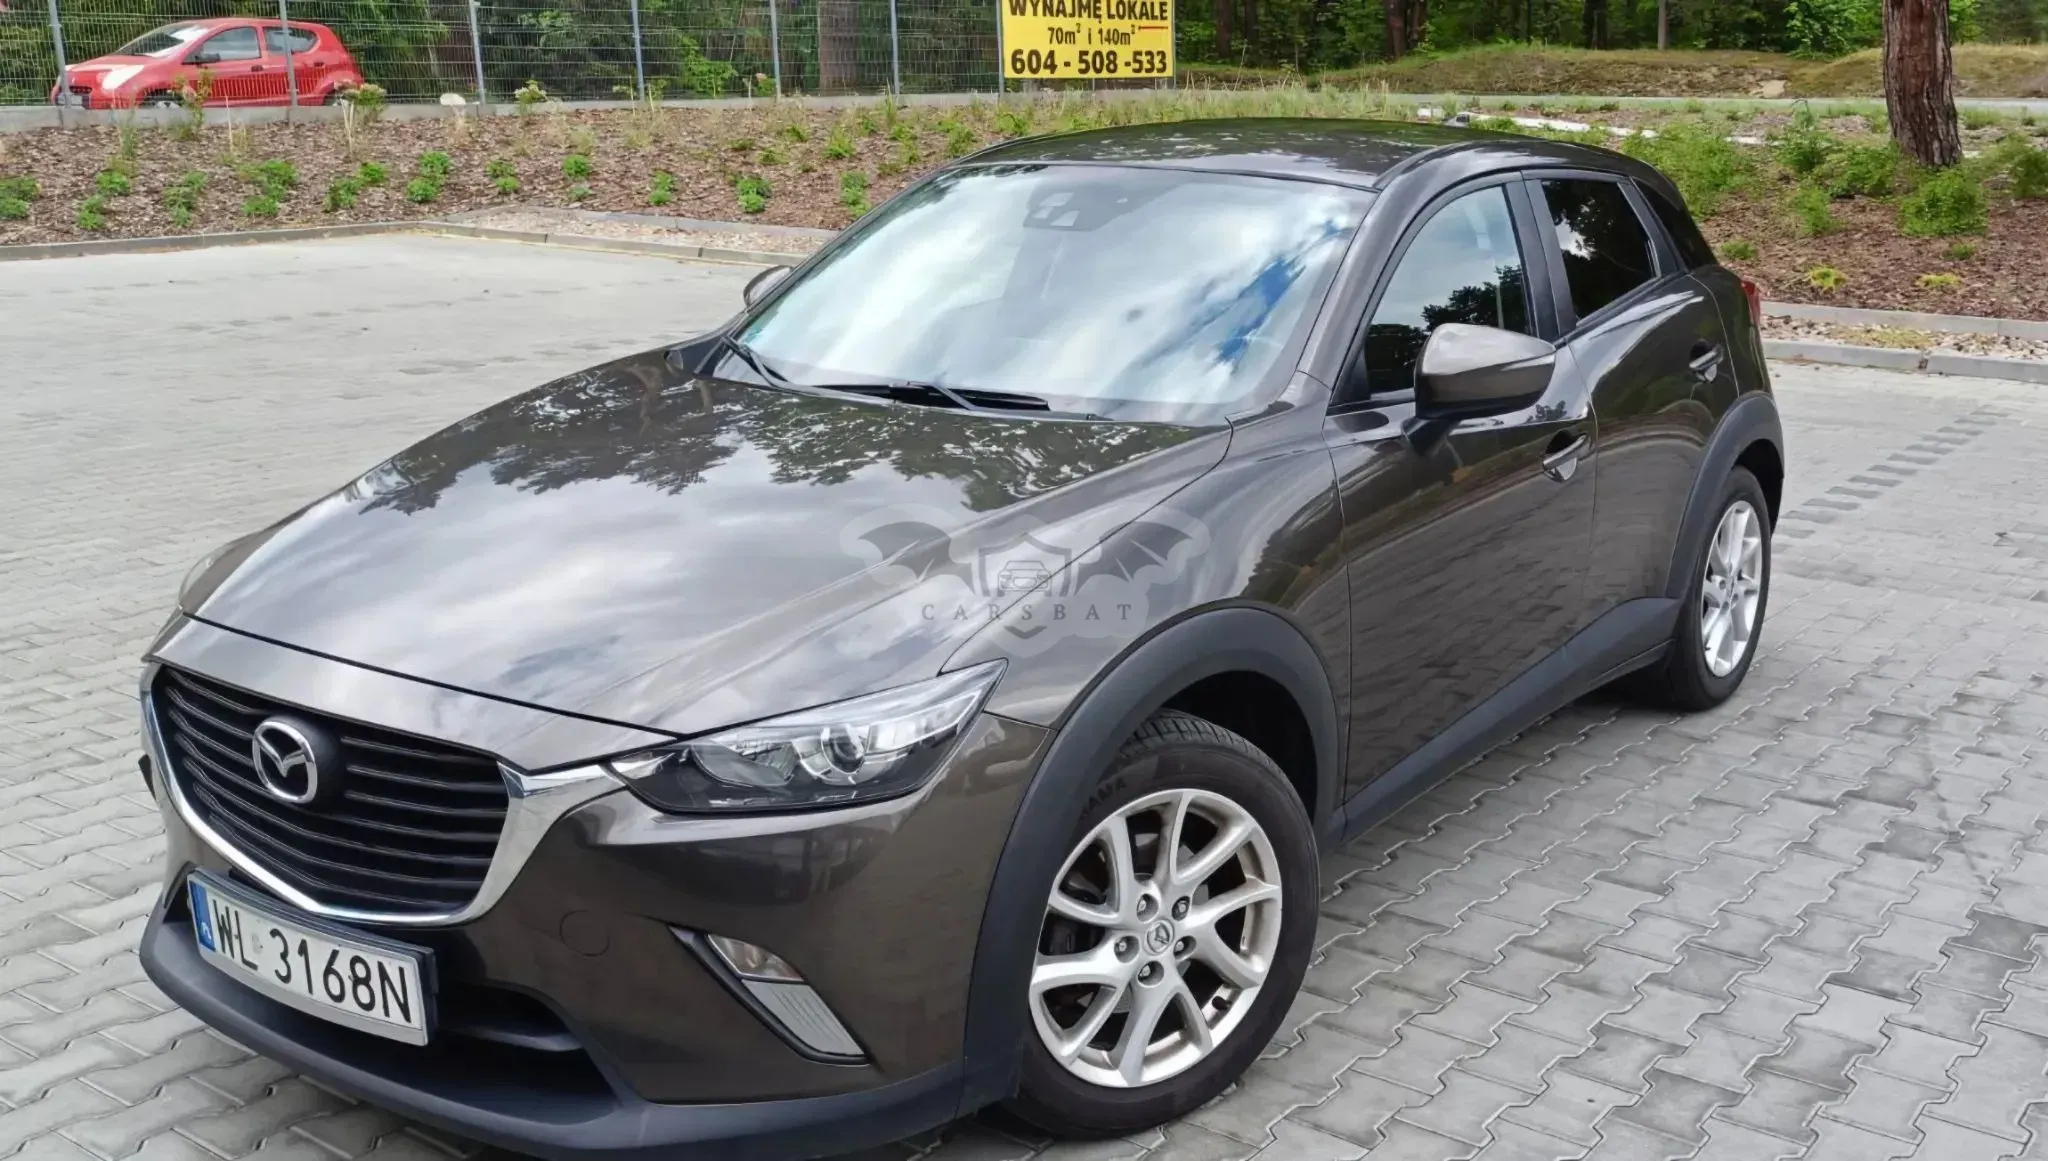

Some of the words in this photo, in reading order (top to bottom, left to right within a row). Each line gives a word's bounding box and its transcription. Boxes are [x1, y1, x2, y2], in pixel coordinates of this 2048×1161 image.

[1009, 0, 1102, 23] WYNAJMĘ
[1107, 0, 1168, 20] LOKALE
[1087, 27, 1092, 45] i
[269, 928, 412, 1023] 3168N
